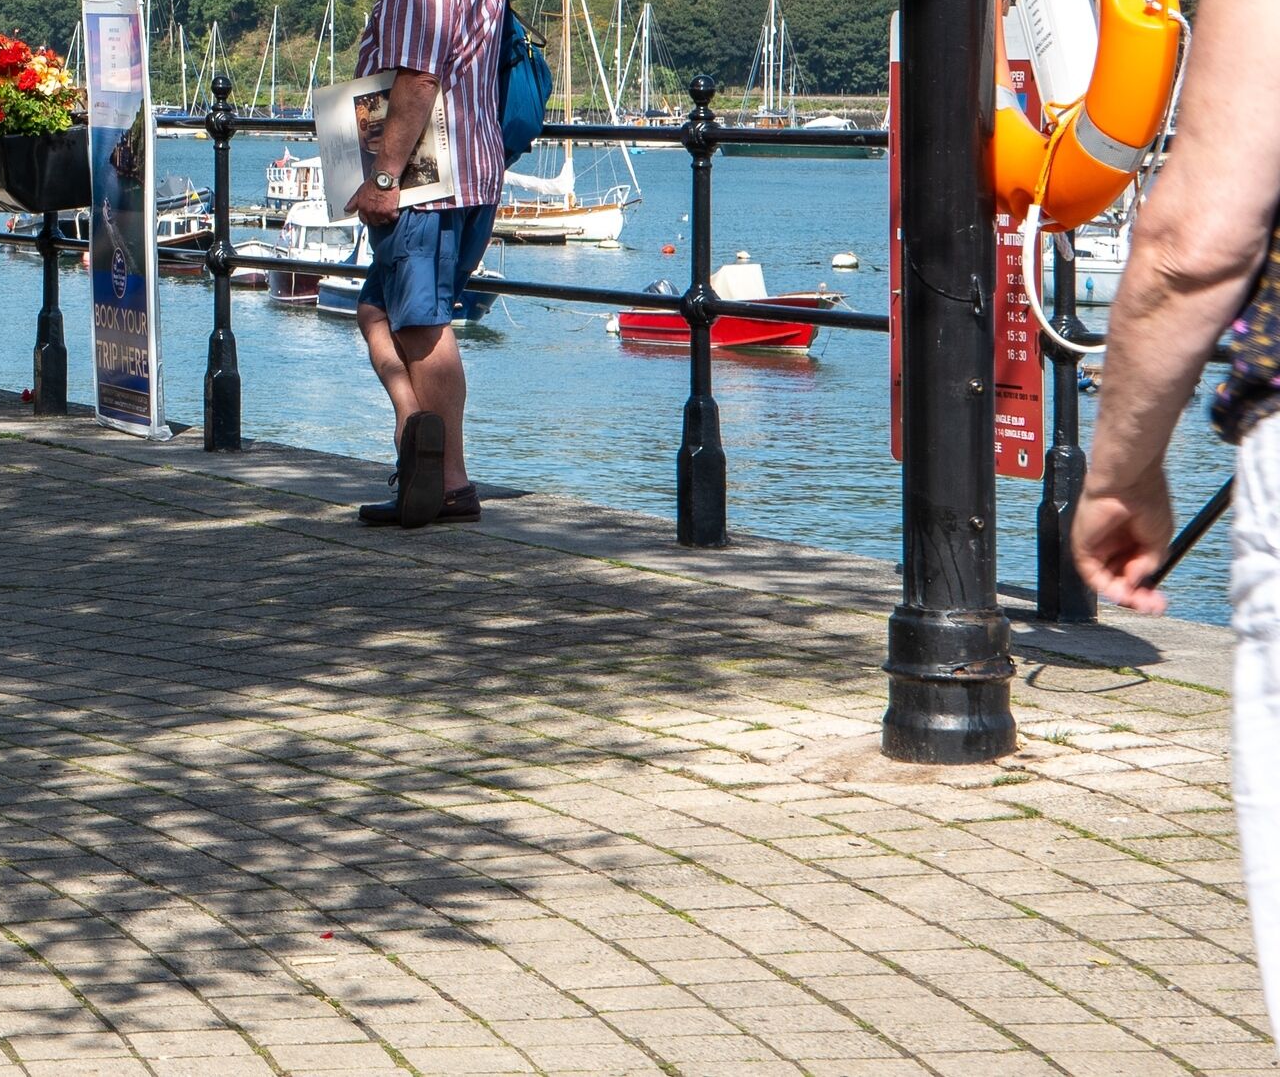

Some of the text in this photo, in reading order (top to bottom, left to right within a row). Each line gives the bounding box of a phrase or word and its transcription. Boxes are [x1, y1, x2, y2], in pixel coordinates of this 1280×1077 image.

[95, 303, 148, 336] BOOK YOUR
[1006, 330, 1027, 342] 15:30
[96, 340, 149, 379] TRIP HERE
[1006, 349, 1027, 362] 16:30
